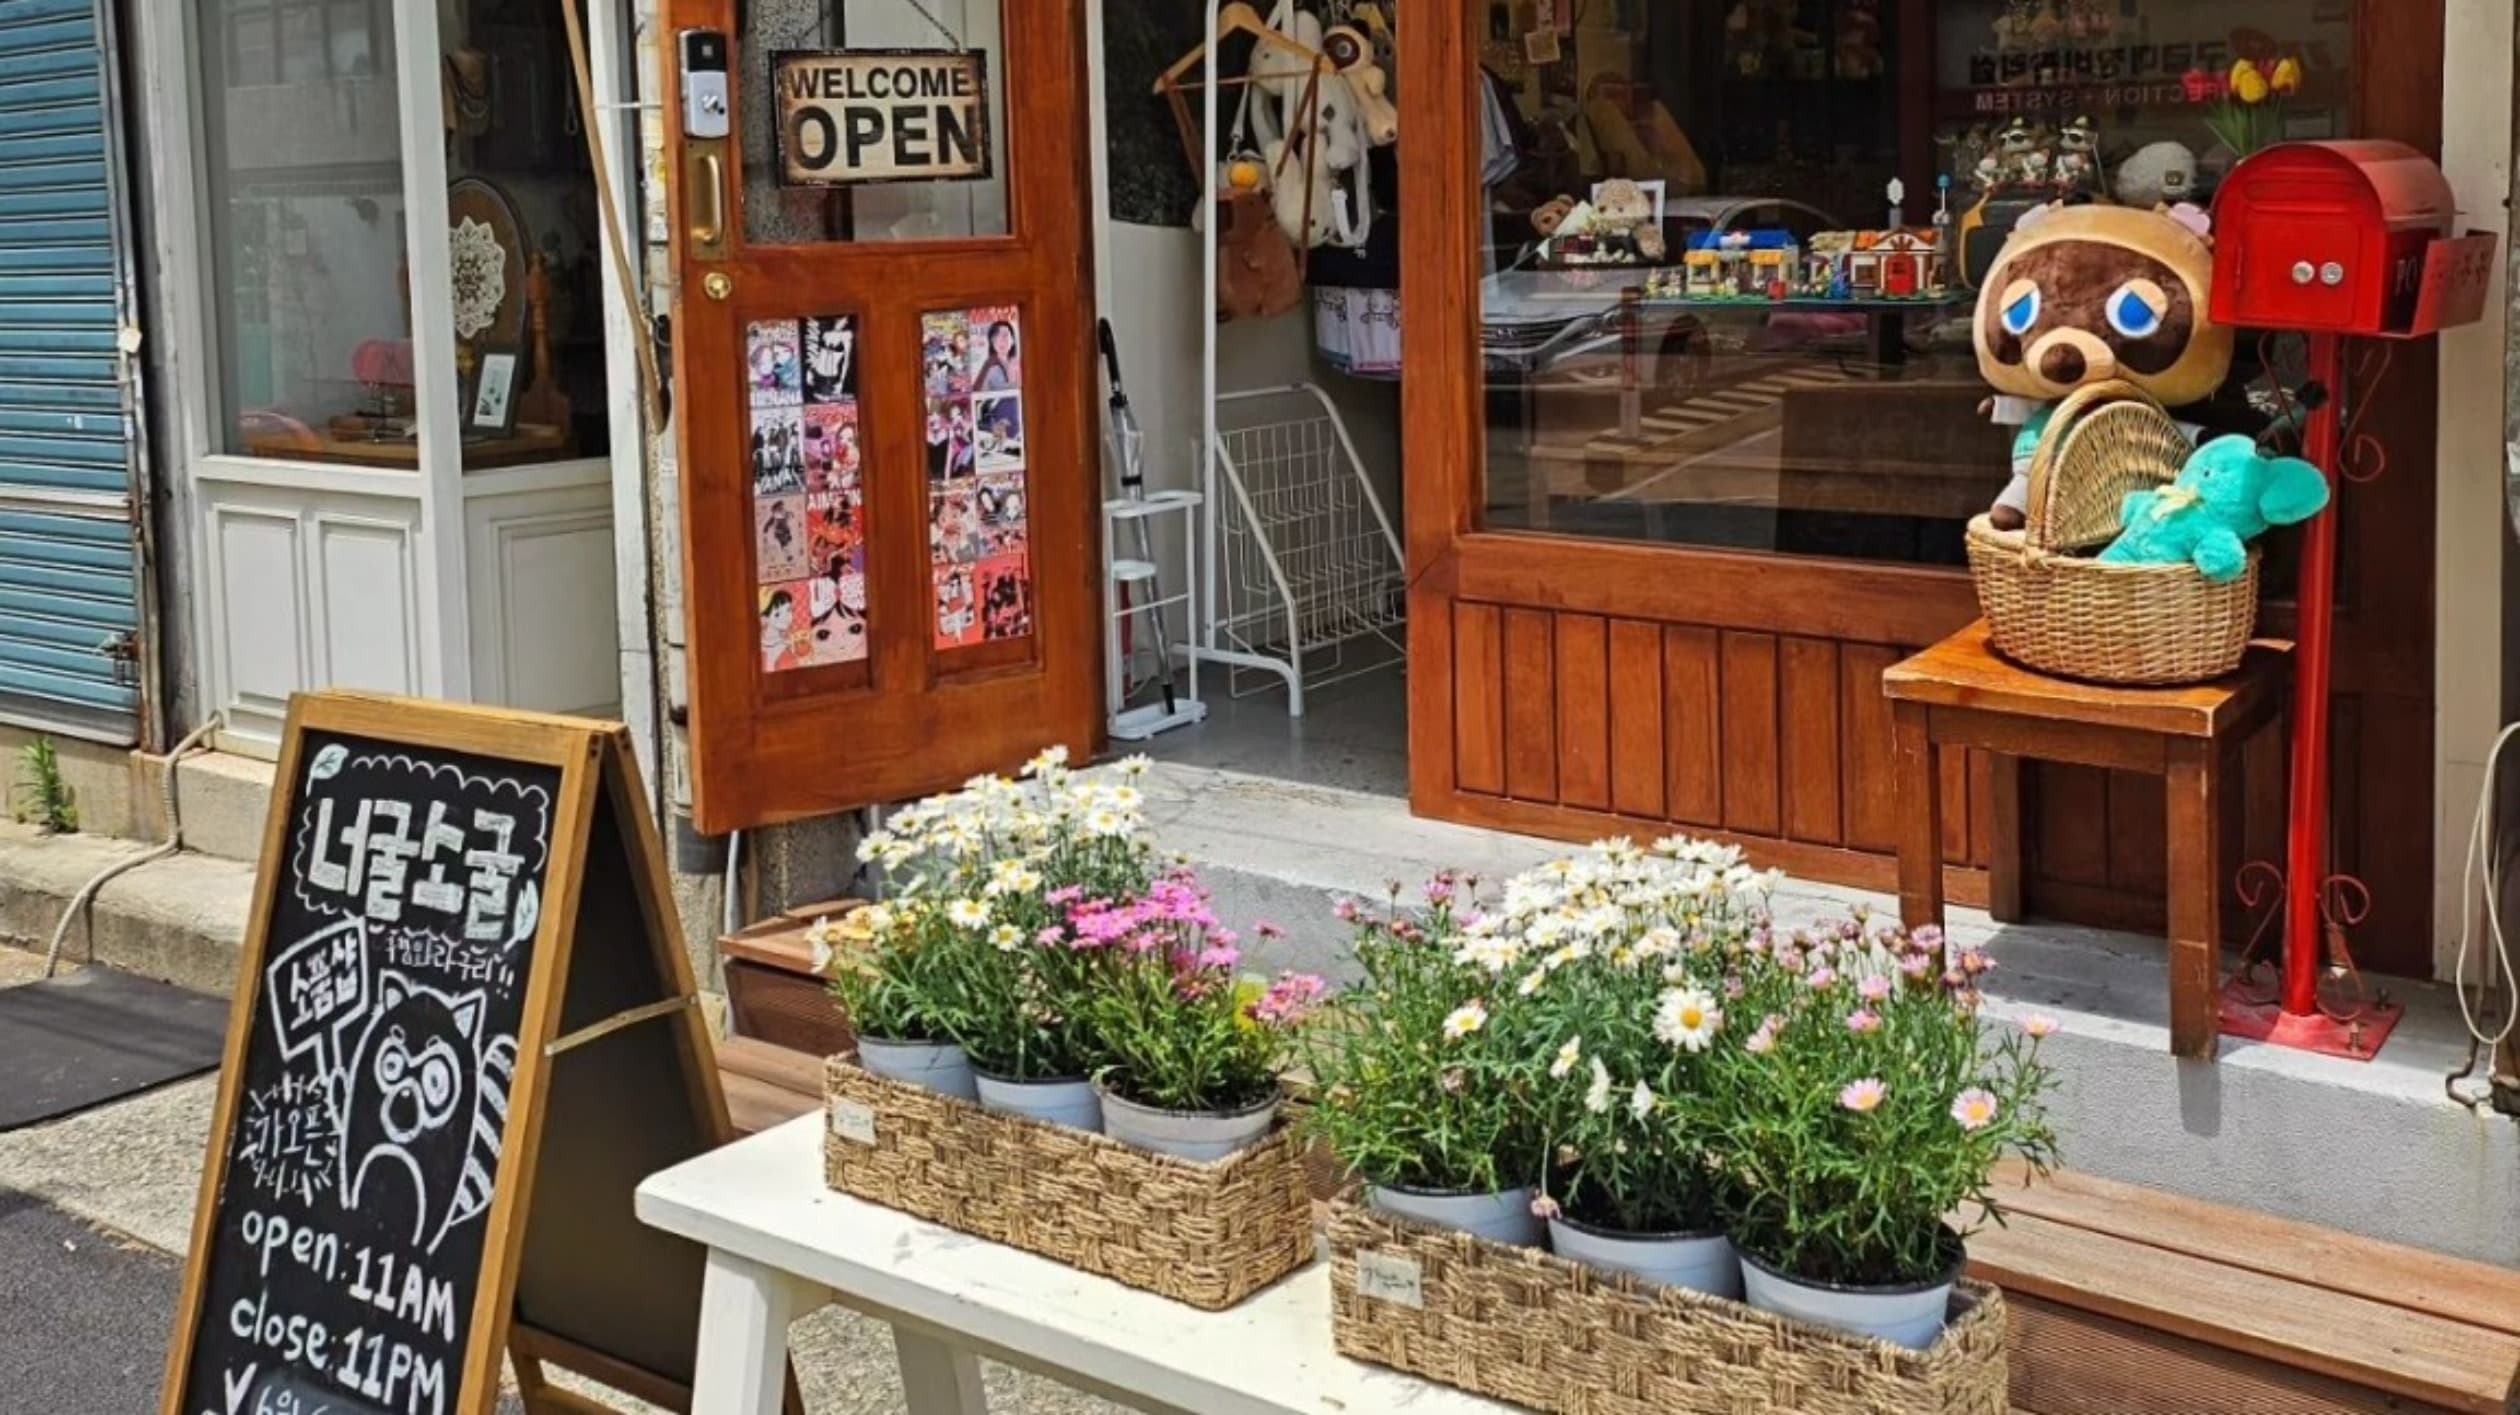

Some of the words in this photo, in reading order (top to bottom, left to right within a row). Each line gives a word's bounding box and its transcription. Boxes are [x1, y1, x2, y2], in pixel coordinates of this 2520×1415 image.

[789, 66, 973, 99] WELCOME
[790, 104, 979, 171] OPEN
[308, 798, 526, 940] 너굴소굴
[290, 931, 357, 1031] 소품샵
